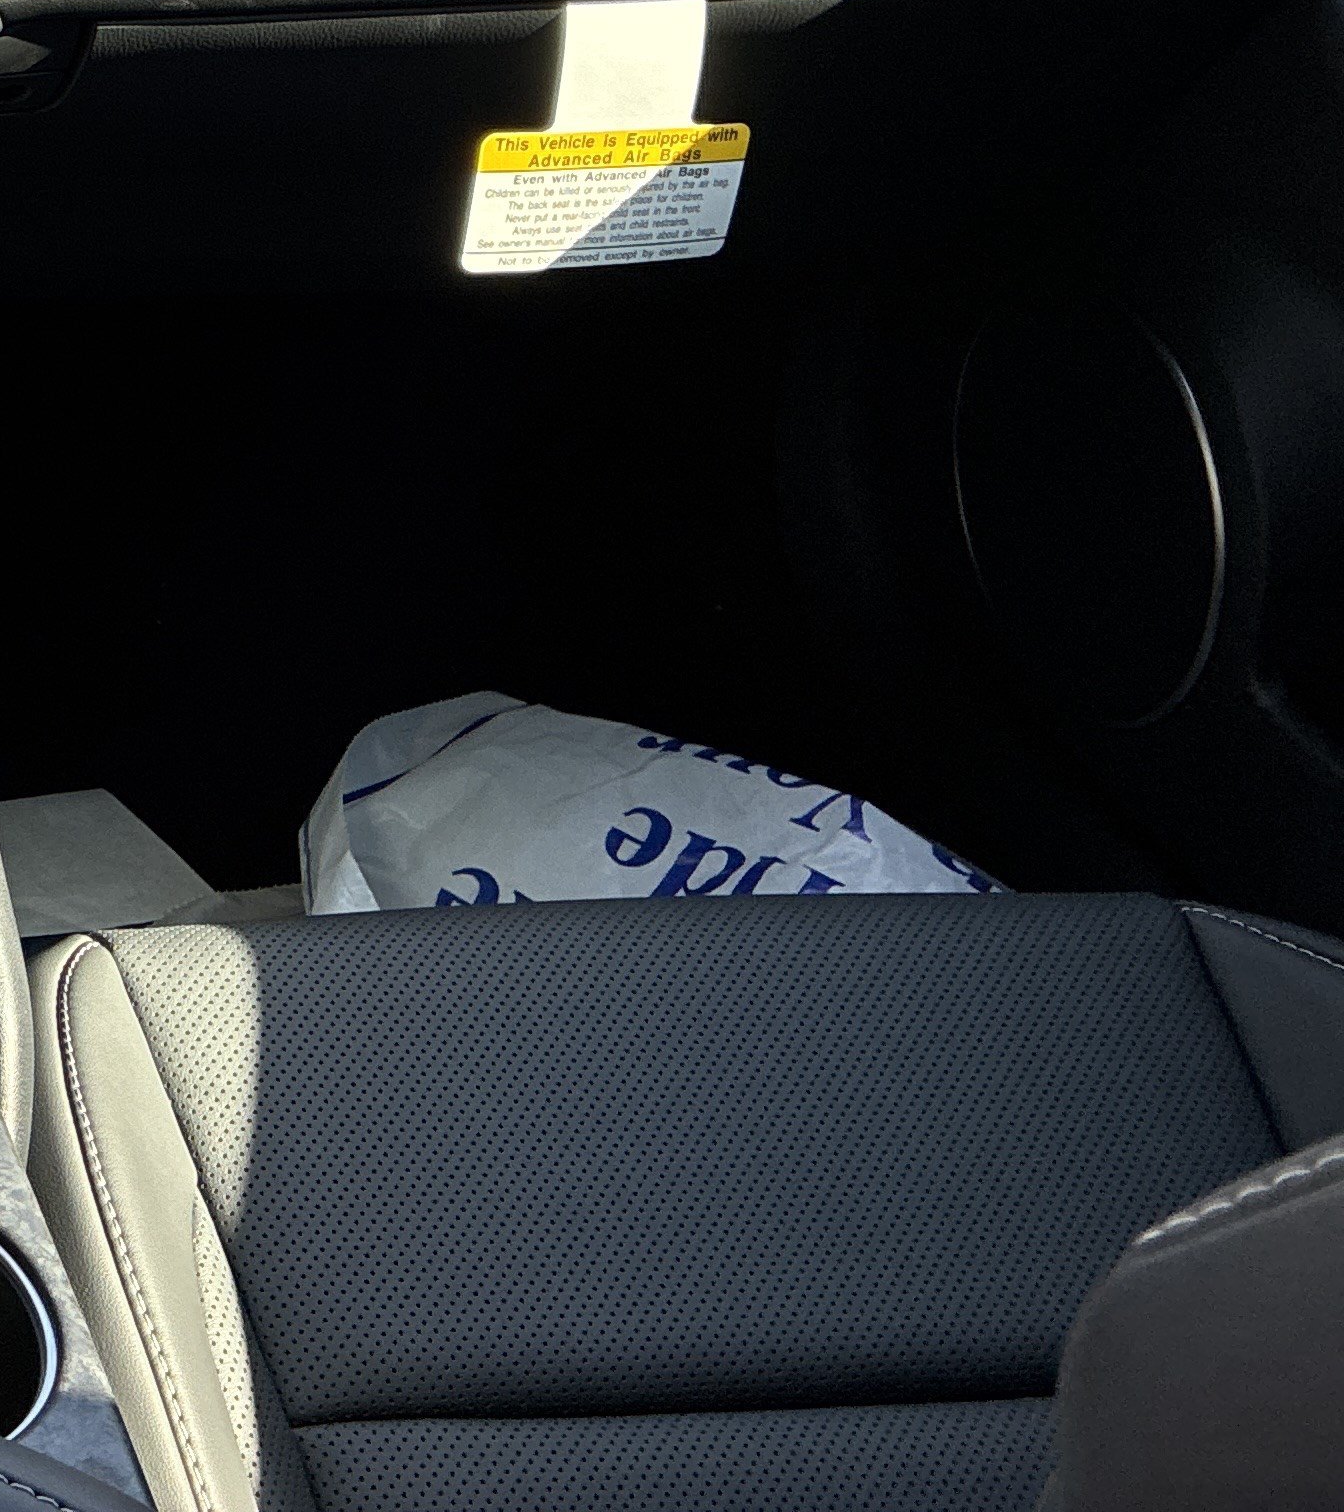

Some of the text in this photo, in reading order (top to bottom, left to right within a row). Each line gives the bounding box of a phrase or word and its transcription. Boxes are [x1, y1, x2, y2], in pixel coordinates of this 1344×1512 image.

[495, 126, 740, 152] This Vehicle is Equipped with
[527, 148, 702, 168] Advanced Air Bags
[513, 174, 545, 186] Even
[551, 172, 578, 184] with
[584, 169, 647, 183] Advanced
[678, 166, 710, 179] Bags
[484, 188, 521, 199] Children
[523, 189, 540, 198] can
[543, 188, 555, 197] be
[583, 187, 594, 195] or
[667, 181, 679, 191] by
[681, 179, 695, 189] the
[698, 179, 710, 188] air
[508, 201, 524, 210] The
[527, 200, 548, 210] back
[552, 199, 570, 209] seat
[573, 200, 581, 208] is
[585, 198, 599, 208] the
[656, 193, 669, 203] for
[504, 213, 531, 224] Never
[533, 212, 549, 224] put
[551, 213, 558, 221] a
[632, 206, 651, 217] seat
[664, 205, 678, 215] the
[512, 225, 542, 237] Always
[545, 226, 562, 235] use
[628, 218, 650, 230] child
[477, 238, 495, 249] See
[498, 238, 531, 248] owner's
[655, 229, 680, 241] about
[497, 256, 518, 267] Not
[522, 256, 533, 266] to
[604, 249, 639, 262] except
[641, 248, 656, 260] by
